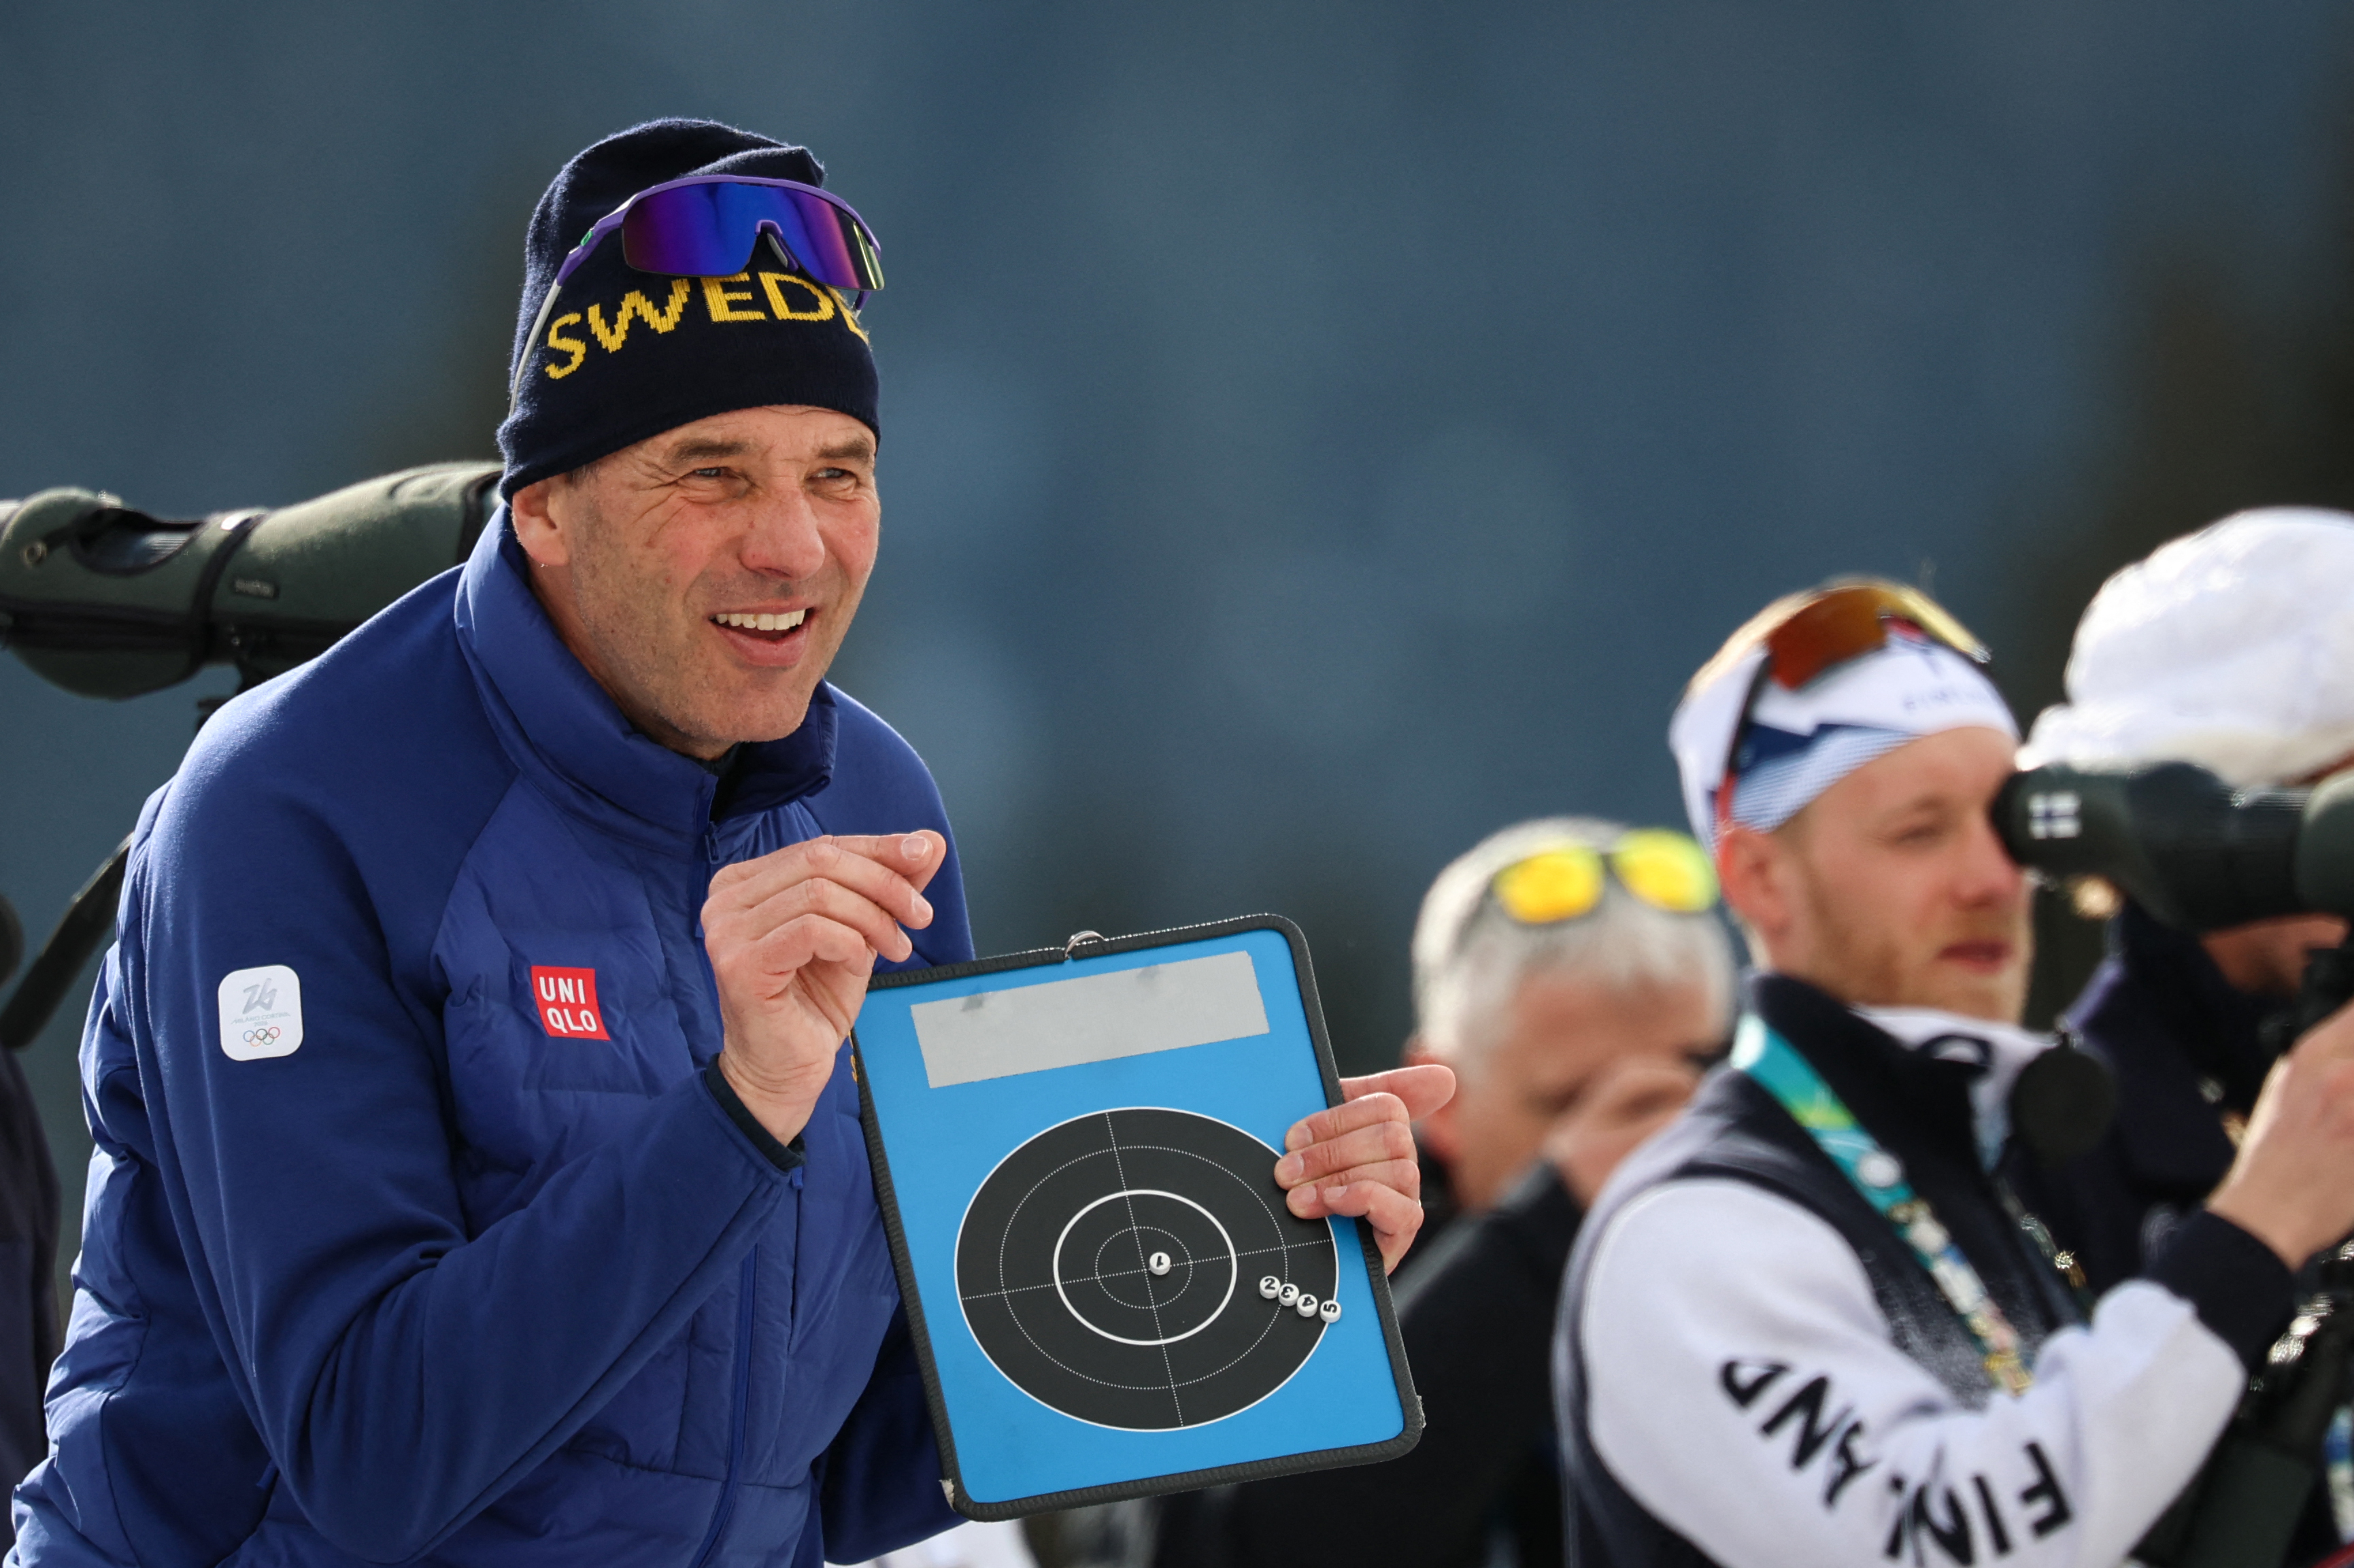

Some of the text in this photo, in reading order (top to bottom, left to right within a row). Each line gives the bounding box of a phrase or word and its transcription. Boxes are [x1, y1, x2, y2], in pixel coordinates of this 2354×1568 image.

[539, 976, 586, 1004] UNI
[547, 1008, 598, 1034] QLO
[1156, 1255, 1164, 1268] 1
[1264, 1278, 1276, 1290] 2
[1281, 1286, 1294, 1299] 3
[1302, 1296, 1315, 1307] 4
[1323, 1303, 1338, 1313] 5
